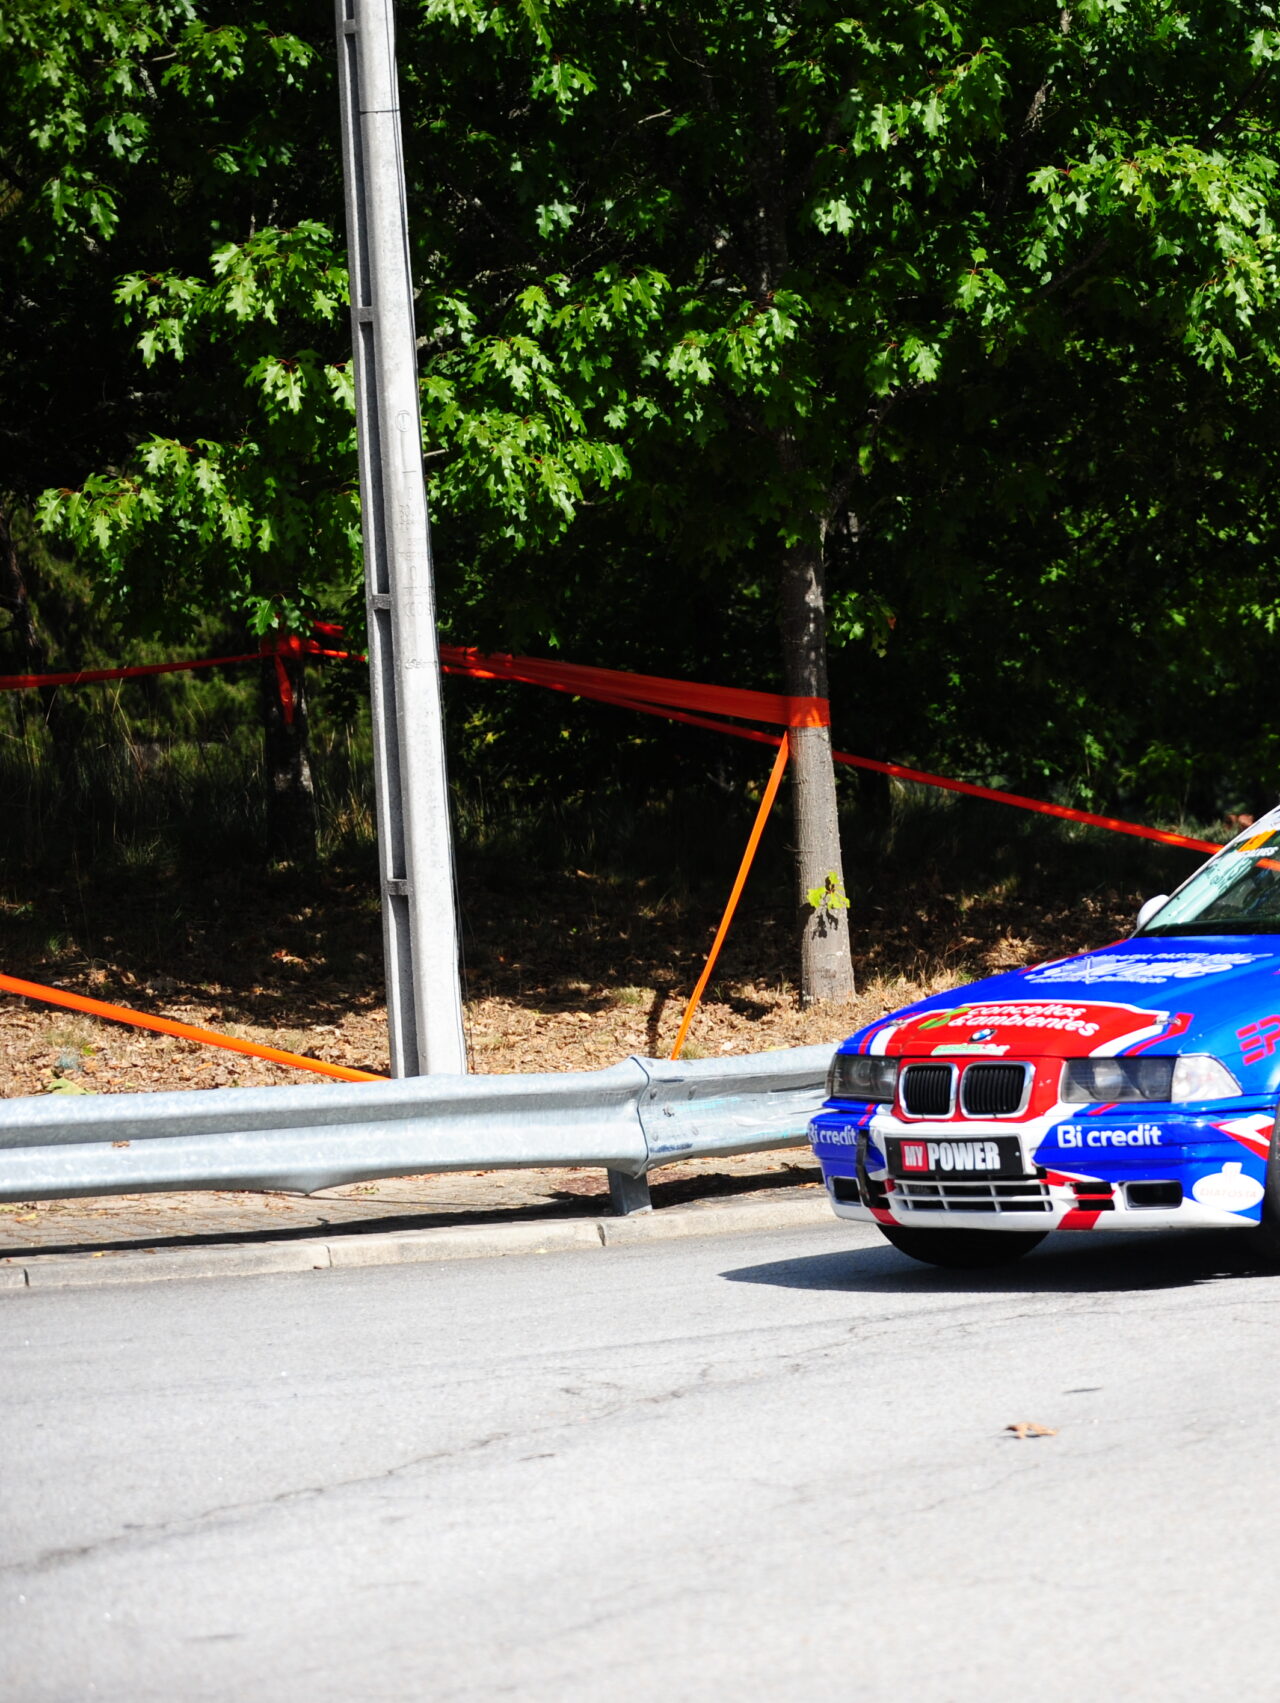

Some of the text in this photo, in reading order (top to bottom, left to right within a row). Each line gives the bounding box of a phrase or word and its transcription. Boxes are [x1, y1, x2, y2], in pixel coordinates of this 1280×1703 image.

[968, 1004, 1086, 1017] conceitos
[820, 1124, 857, 1146] credit
[1057, 1124, 1162, 1148] Bi credit
[904, 1142, 1000, 1171] MY POWER
